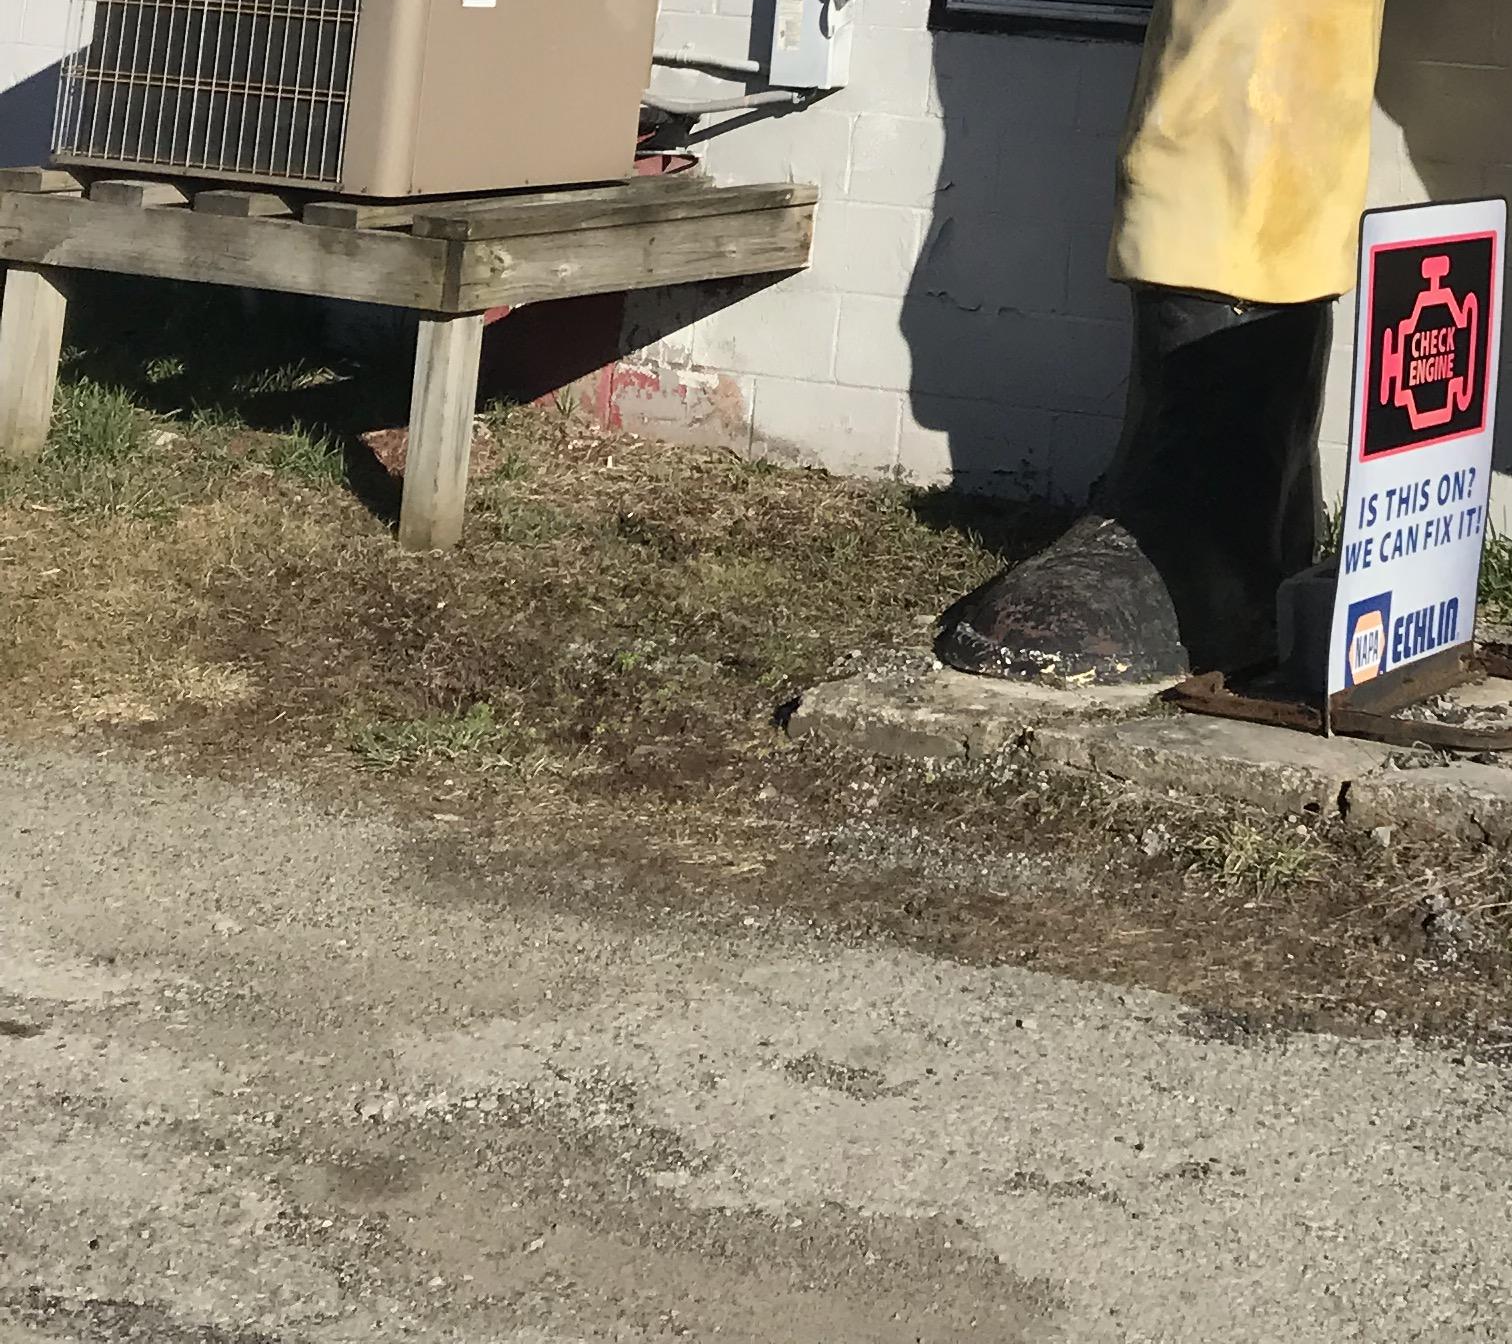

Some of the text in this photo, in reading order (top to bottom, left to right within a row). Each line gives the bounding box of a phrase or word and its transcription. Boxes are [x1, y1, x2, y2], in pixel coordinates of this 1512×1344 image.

[1409, 353, 1455, 386] ENGINE
[1412, 326, 1455, 358] CHECK
[1358, 467, 1476, 529] IS THIS ON?
[1345, 505, 1482, 575] WE CAN FIX IT!
[1355, 597, 1459, 670] NAPA ECHLIN
